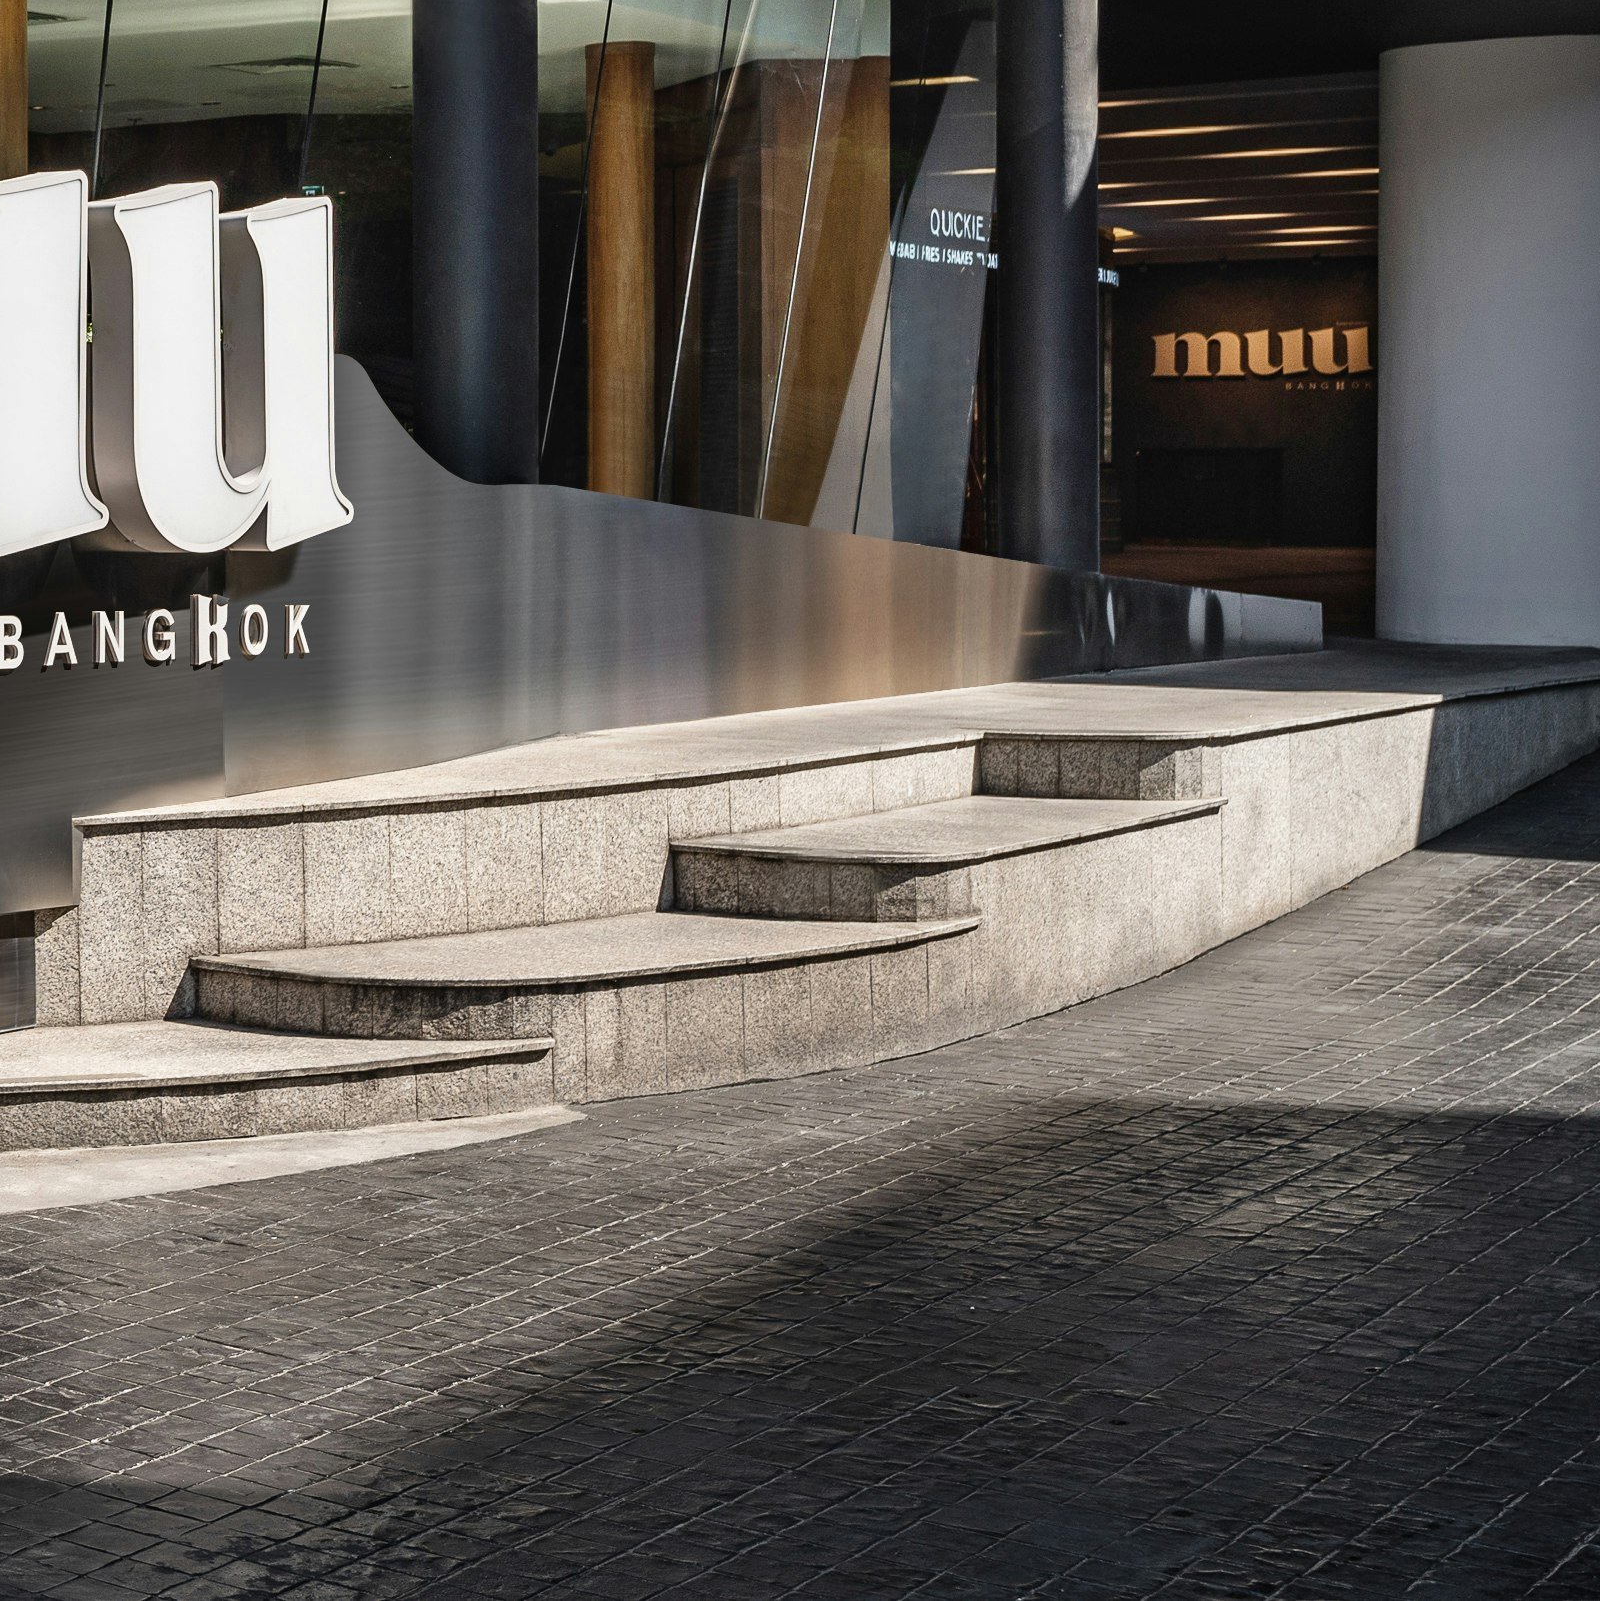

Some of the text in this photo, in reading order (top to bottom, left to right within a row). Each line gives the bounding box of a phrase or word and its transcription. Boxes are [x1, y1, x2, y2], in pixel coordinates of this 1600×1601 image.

[930, 207, 986, 243] QUICKIE
[946, 248, 973, 266] SHAKES
[1150, 326, 1375, 378] muu
